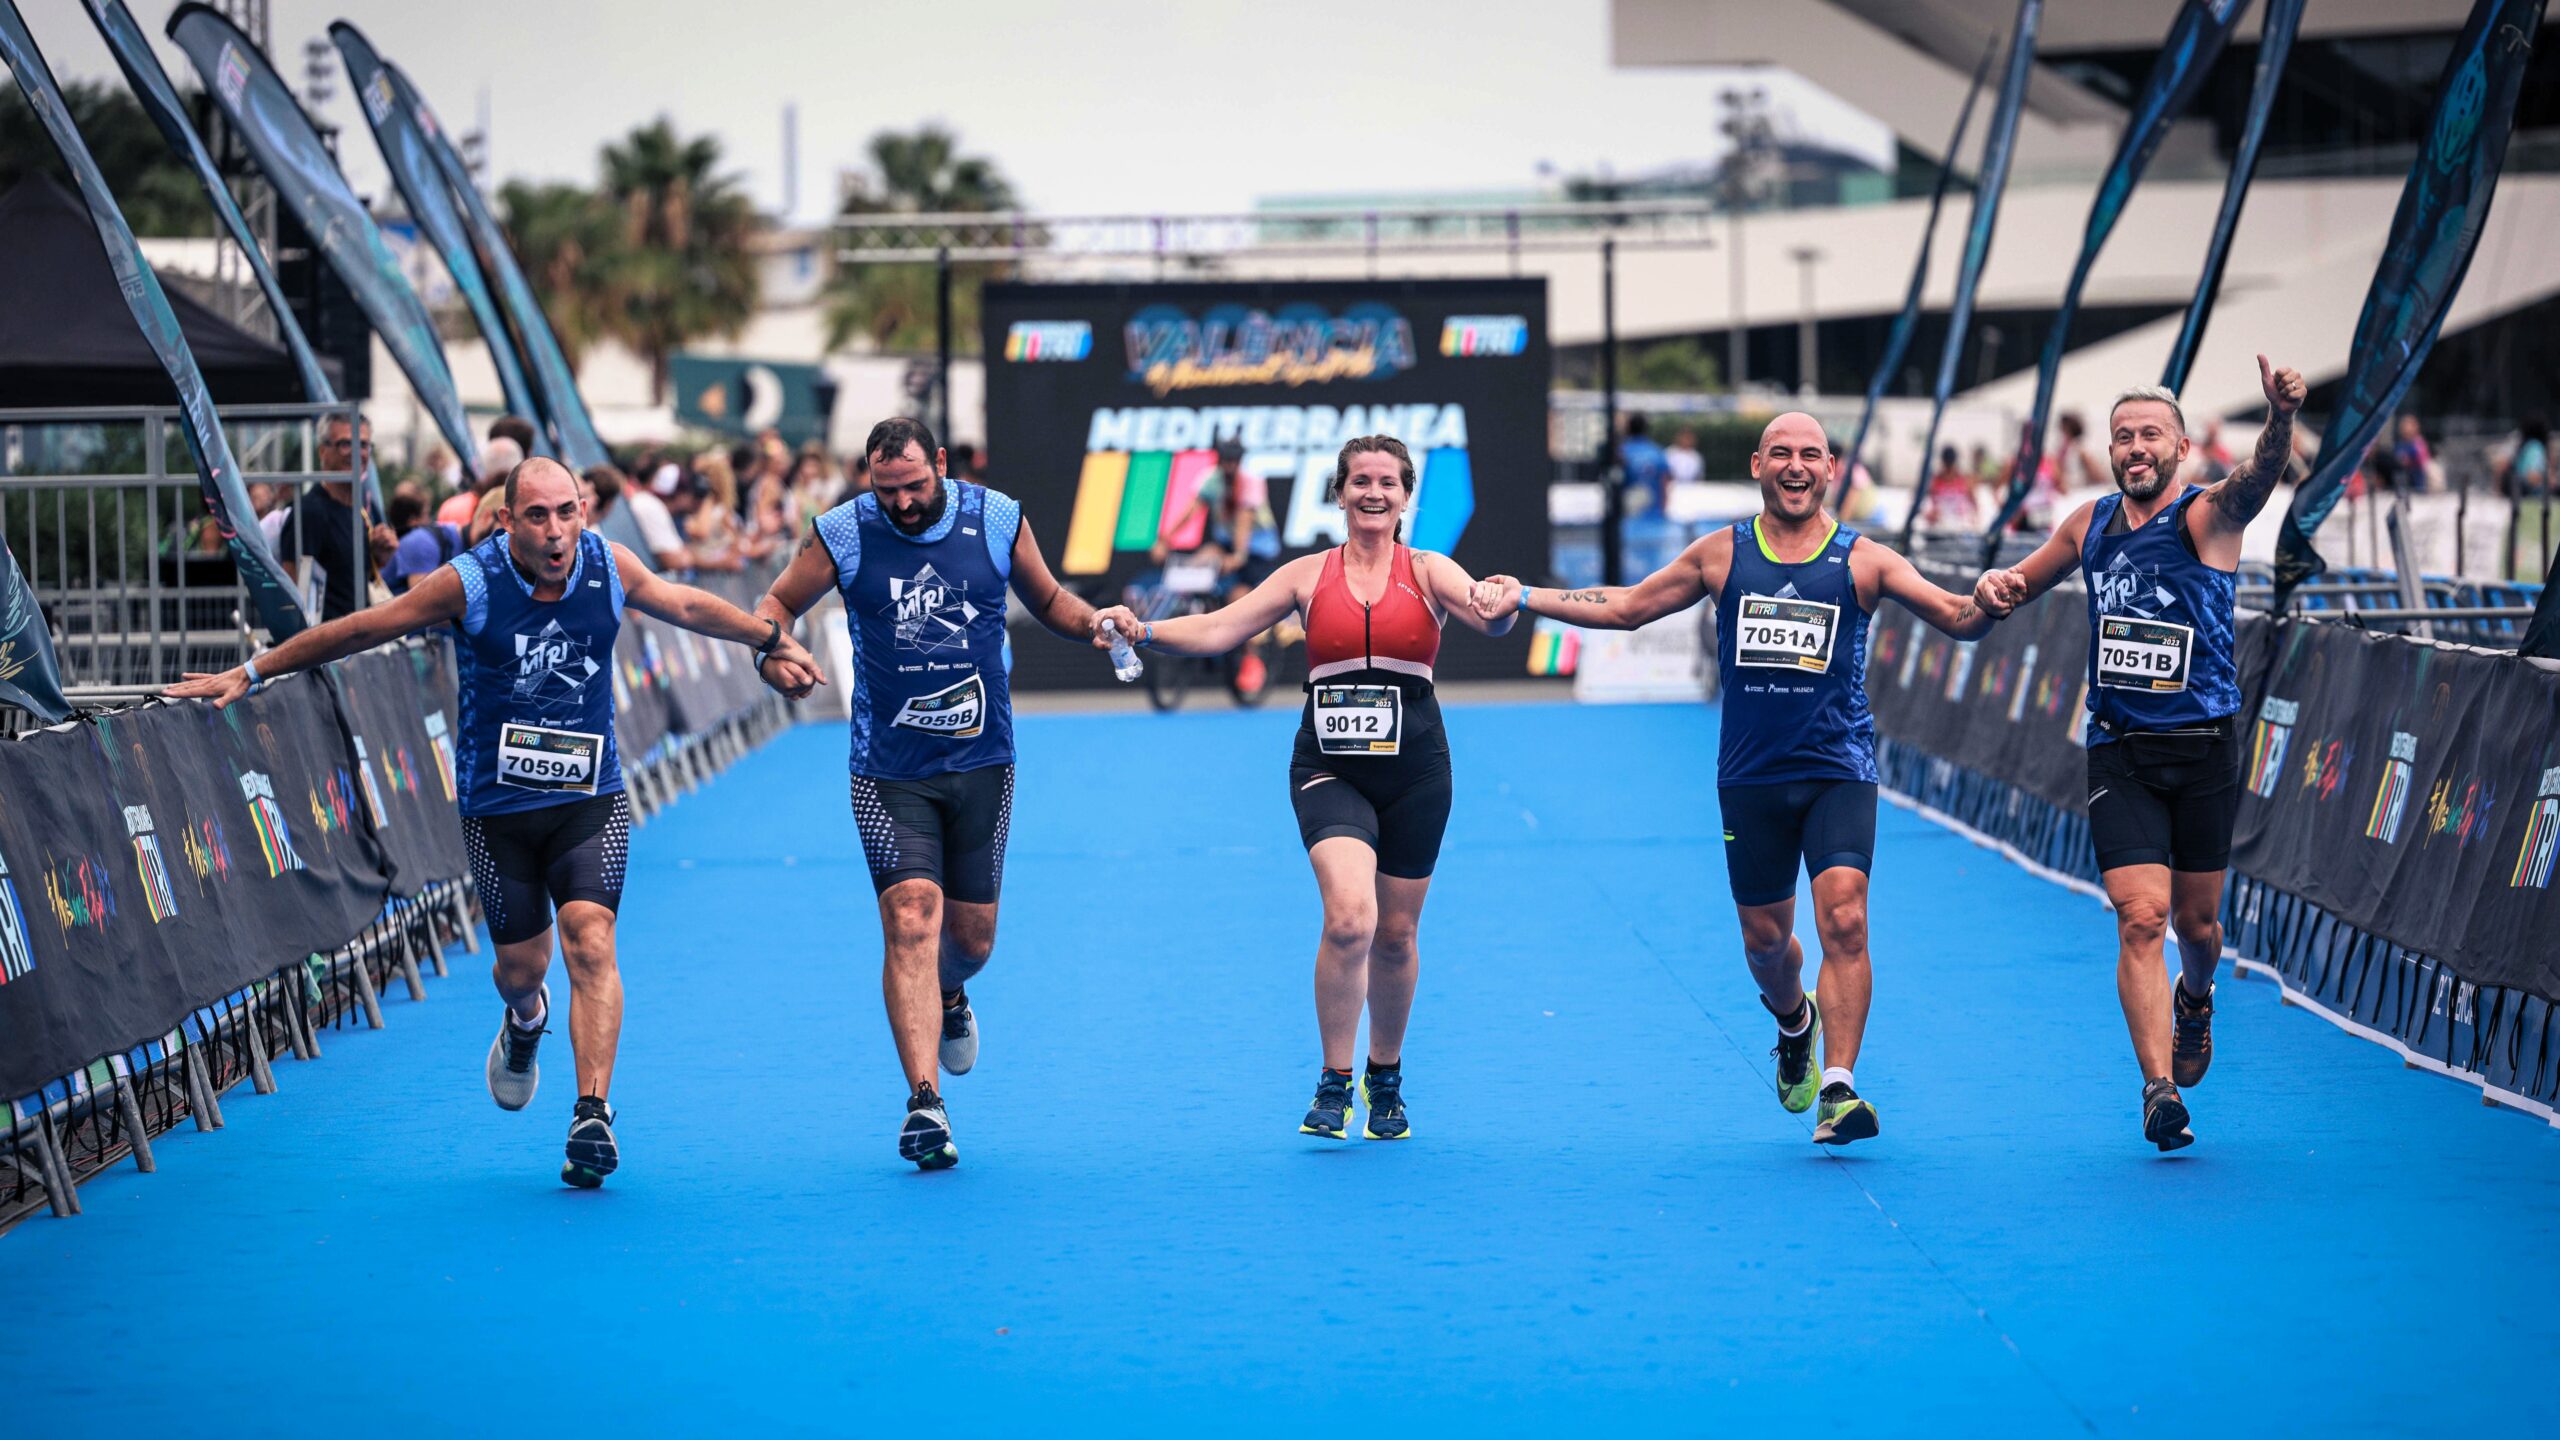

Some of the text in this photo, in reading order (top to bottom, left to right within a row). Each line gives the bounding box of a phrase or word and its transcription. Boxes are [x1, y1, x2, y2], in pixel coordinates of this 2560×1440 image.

[1087, 403, 1469, 452] MEDITERRANEA
[1808, 616, 1826, 626] 2023
[1744, 626, 1817, 650] 7051A
[2162, 638, 2180, 647] 2023
[2102, 647, 2172, 672] 7051B
[1375, 700, 1392, 708] 2023
[906, 708, 973, 727] 7059B
[1326, 715, 1378, 733] 9012
[571, 748, 590, 757] 2023
[506, 755, 583, 779] 7059A
